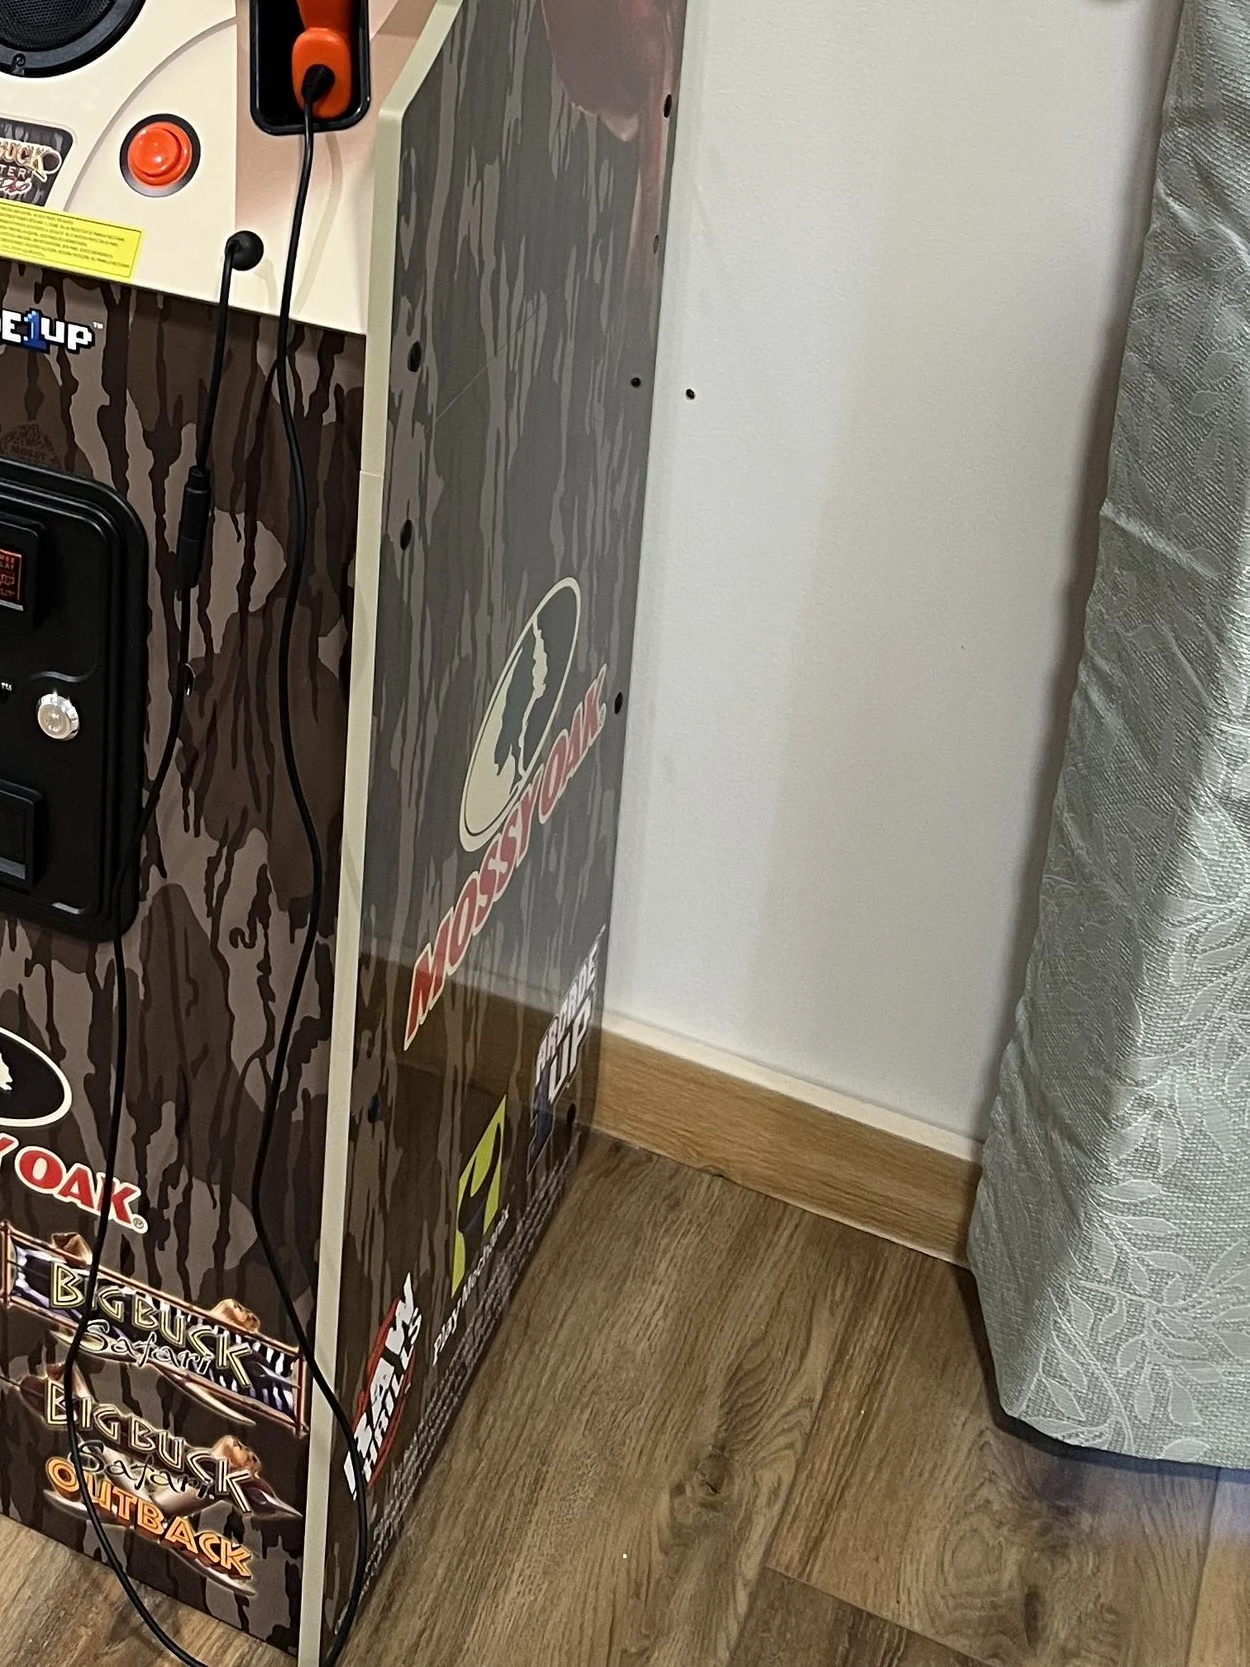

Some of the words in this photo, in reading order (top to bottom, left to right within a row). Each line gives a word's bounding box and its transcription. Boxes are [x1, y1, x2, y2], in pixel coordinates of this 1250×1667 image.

[404, 764, 544, 1051] MOSSY
[538, 664, 607, 824] OAK
[535, 939, 599, 1087] ARCADE
[17, 1148, 141, 1227] OAK
[80, 1319, 213, 1376] Safari
[131, 1290, 252, 1388] BUCK
[433, 1297, 462, 1367] Play
[343, 1272, 415, 1502] RAW
[354, 1306, 423, 1499] HRILLS
[70, 1439, 218, 1501] Safari
[127, 1417, 253, 1514] BUCK
[47, 1456, 252, 1579] OUTBACK
